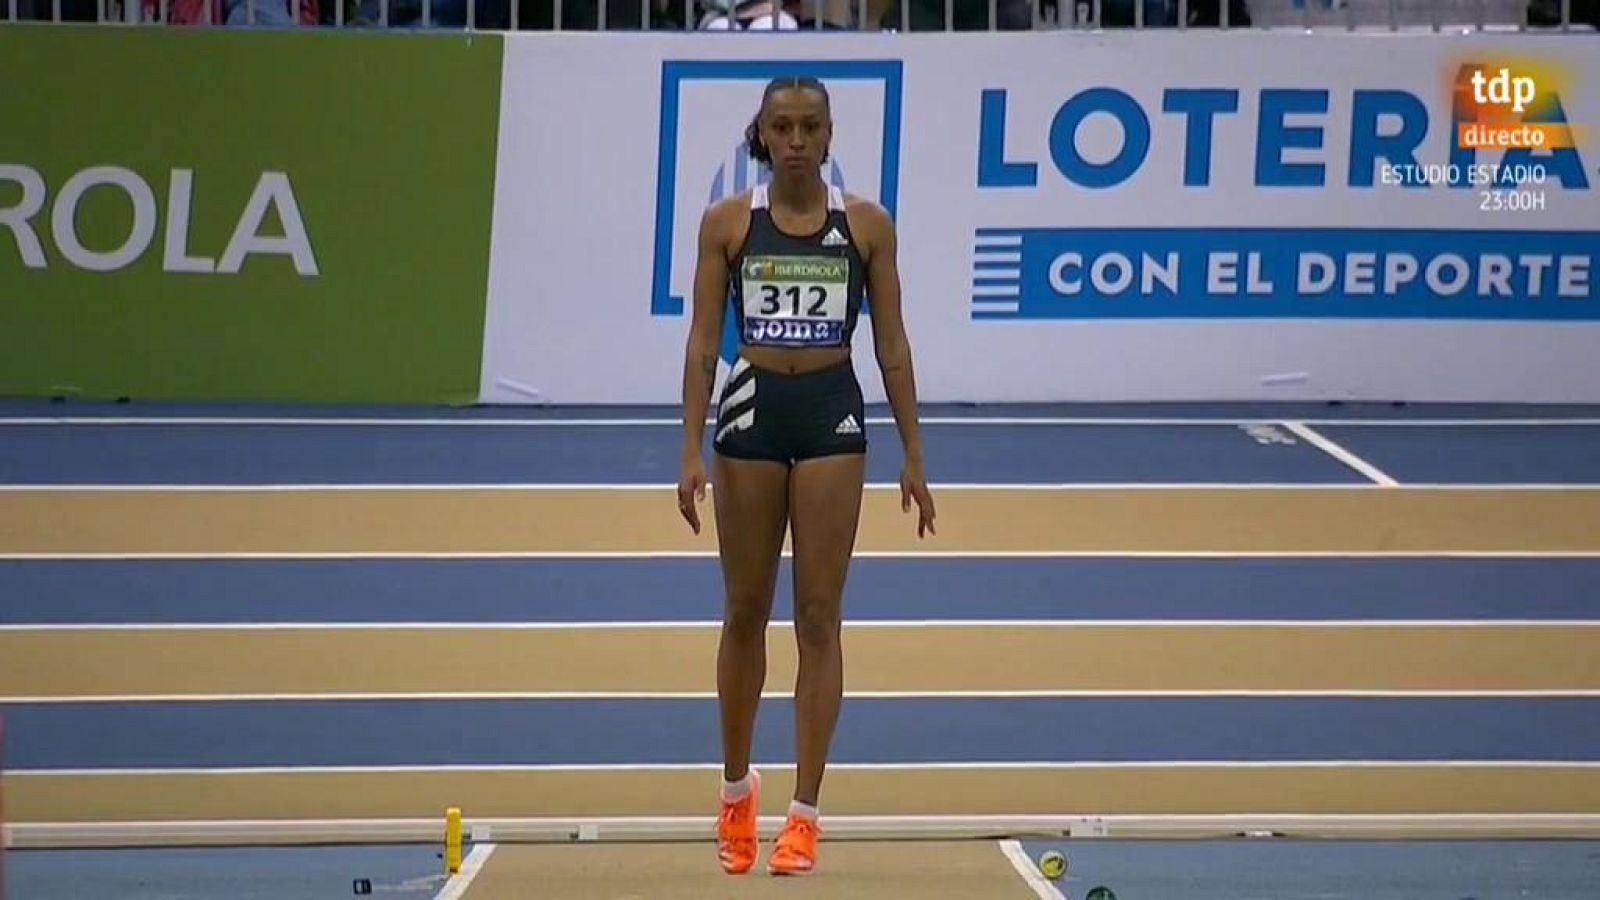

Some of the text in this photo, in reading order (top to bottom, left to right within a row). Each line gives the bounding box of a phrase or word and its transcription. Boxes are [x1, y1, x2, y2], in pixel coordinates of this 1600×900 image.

[977, 63, 1600, 189] LOTERÍA
[774, 263, 841, 277] IBERDROLA
[1048, 252, 1590, 297] CON EL DEPORTE
[760, 285, 828, 317] 312
